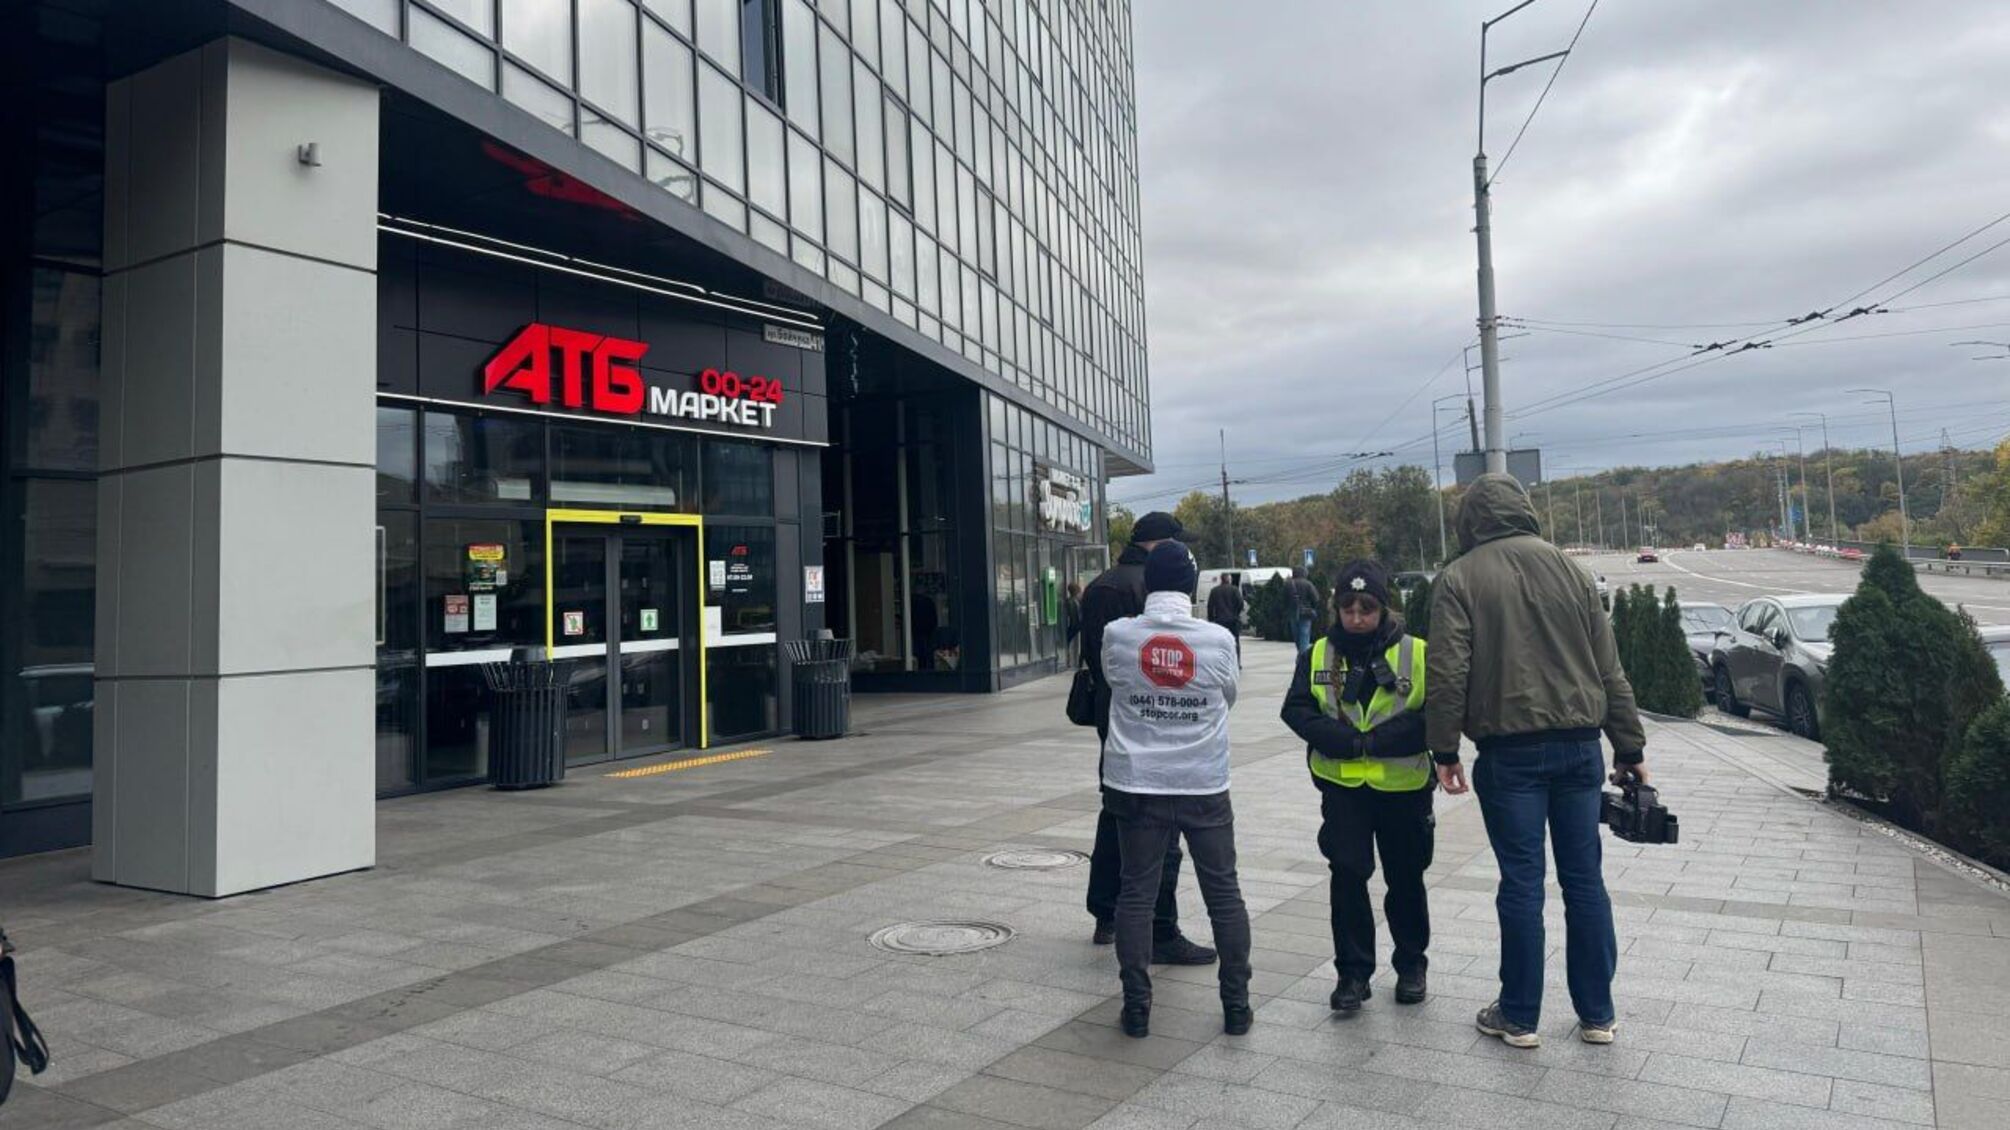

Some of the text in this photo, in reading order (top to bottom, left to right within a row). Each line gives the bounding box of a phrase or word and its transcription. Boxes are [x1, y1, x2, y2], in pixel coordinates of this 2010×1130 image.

[484, 322, 776, 427] АТБ МАРКЕТ
[701, 368, 783, 402] 00-24
[1151, 647, 1183, 667] STOP
[1129, 695, 1155, 709] (044)
[1140, 708, 1199, 721] stopcor.org
